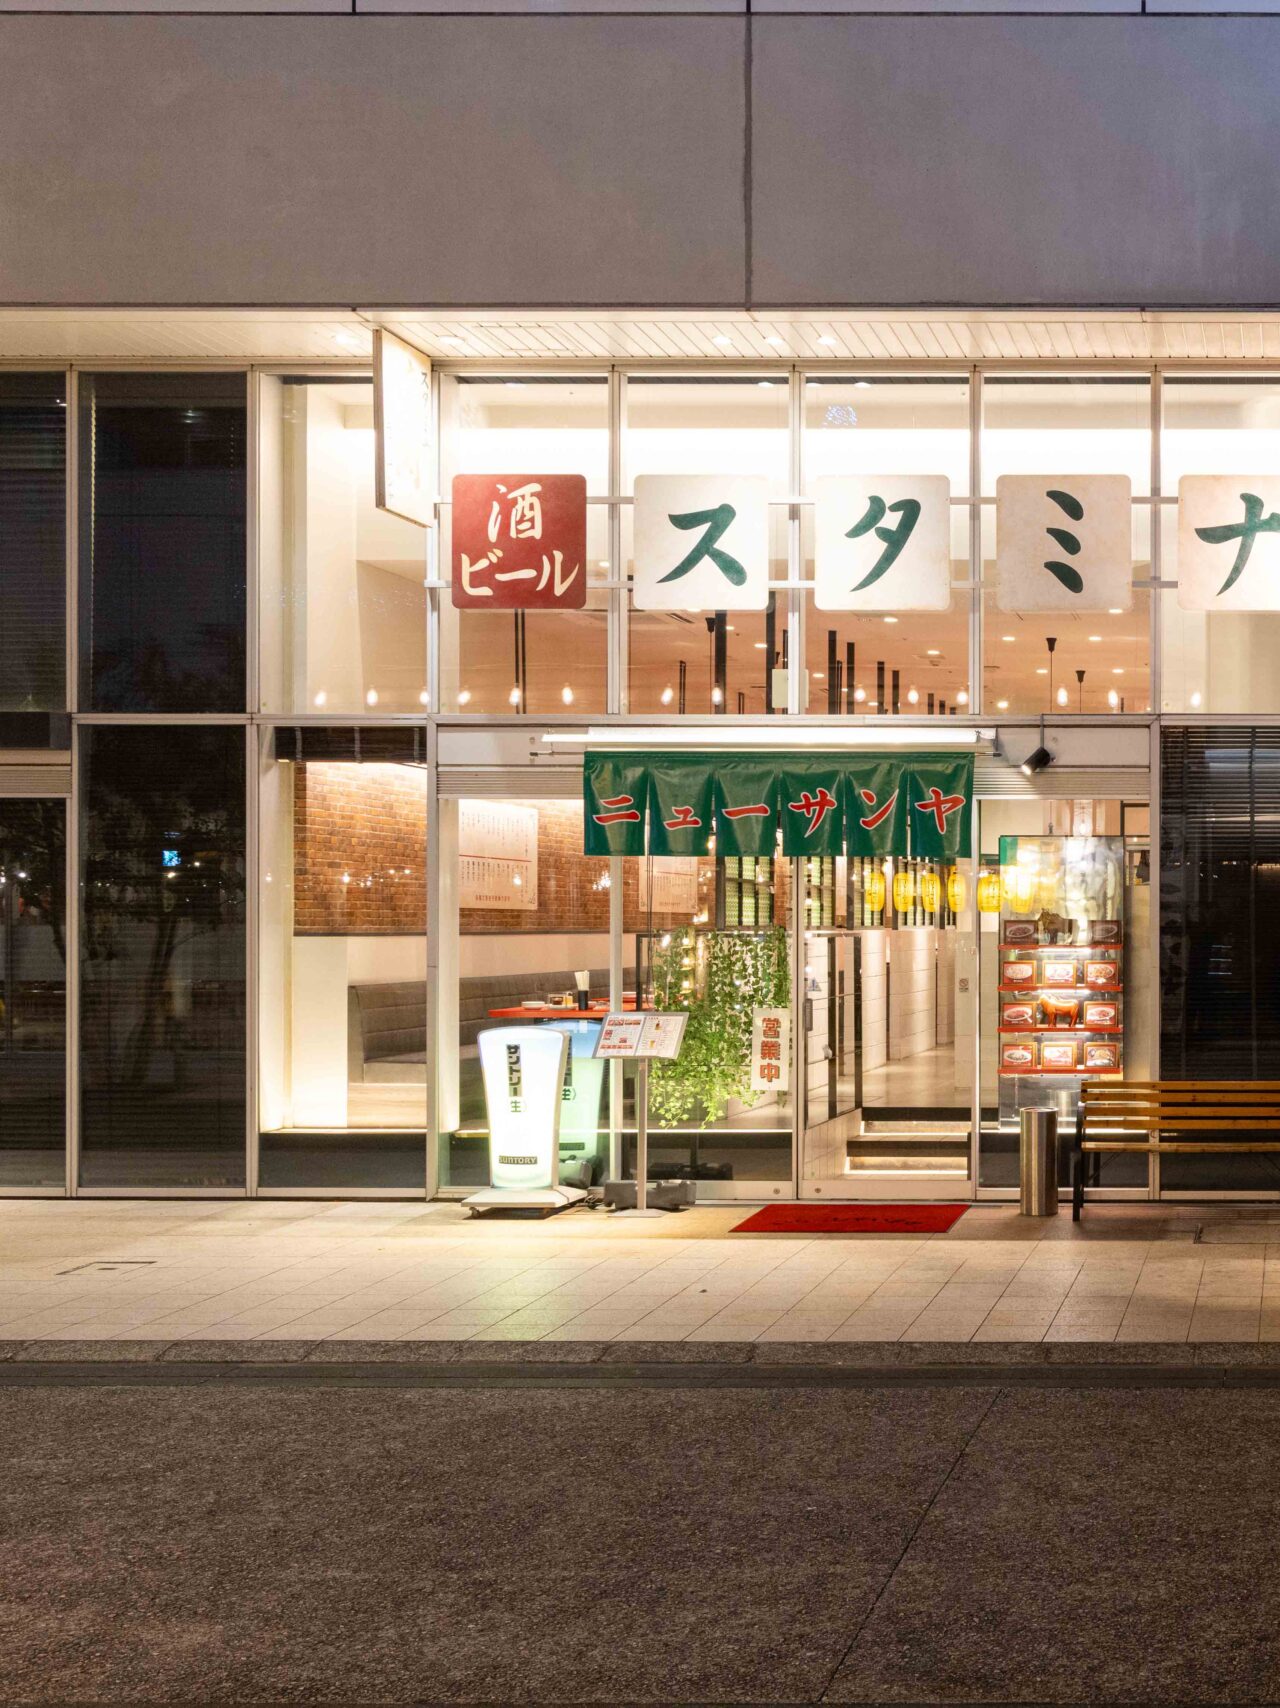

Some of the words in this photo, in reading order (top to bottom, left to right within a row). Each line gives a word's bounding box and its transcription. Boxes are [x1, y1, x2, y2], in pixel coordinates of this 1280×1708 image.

[487, 483, 542, 542] 酒
[460, 549, 580, 597] ビール
[592, 786, 966, 838] ニューサンヤ
[507, 1045, 521, 1096] サントリー
[760, 1017, 781, 1083] 営業中
